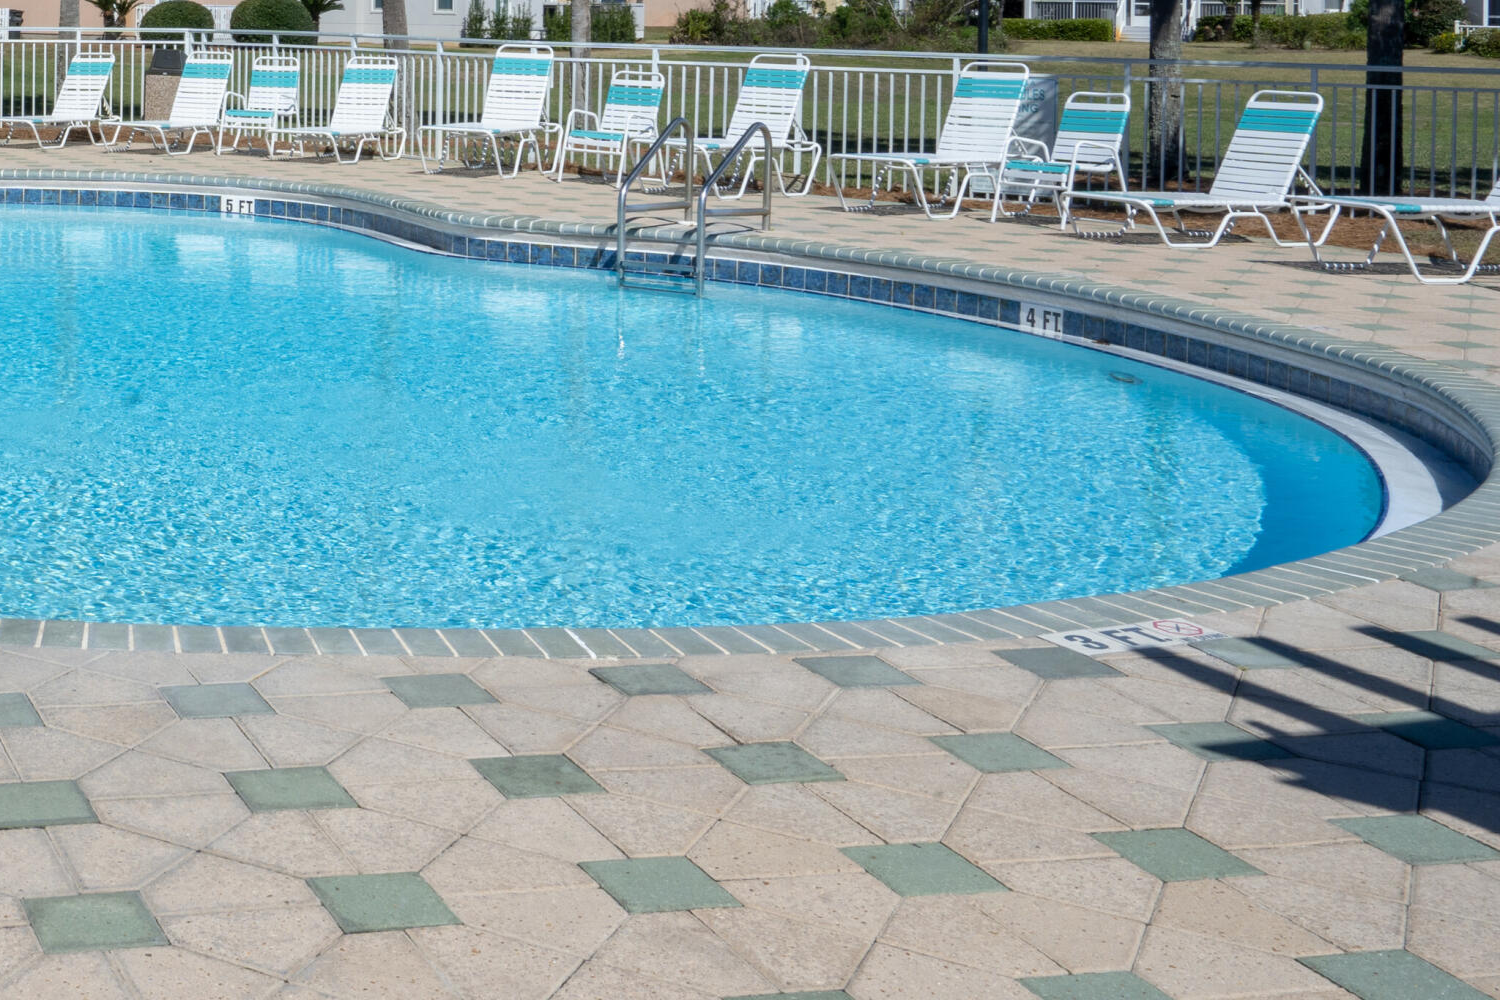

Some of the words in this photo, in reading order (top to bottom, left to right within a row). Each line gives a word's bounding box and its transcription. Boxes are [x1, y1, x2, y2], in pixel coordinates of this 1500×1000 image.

[226, 199, 233, 212] 5
[1026, 307, 1036, 328] 4
[1064, 634, 1109, 650] 3
